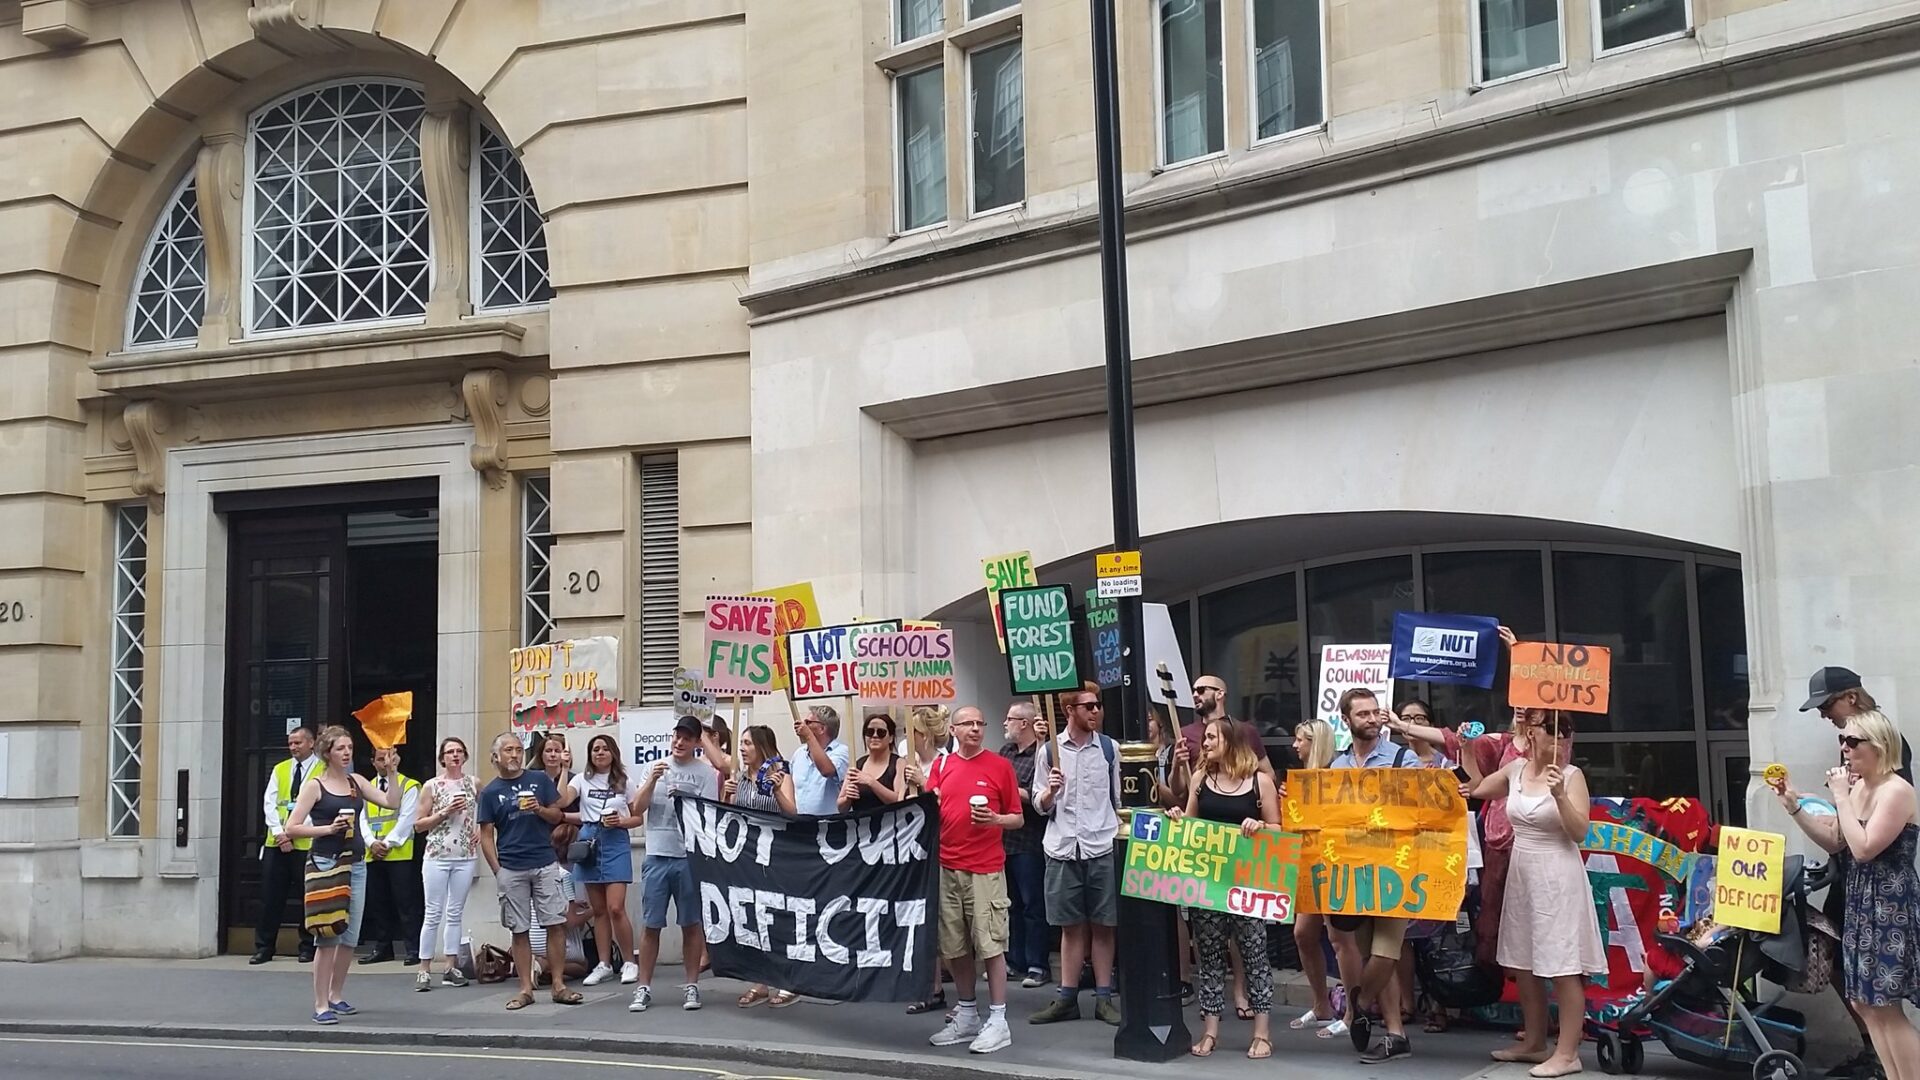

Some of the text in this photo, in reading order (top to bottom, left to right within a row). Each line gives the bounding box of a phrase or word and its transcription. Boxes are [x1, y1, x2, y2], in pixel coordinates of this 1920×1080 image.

[568, 569, 601, 594] 20
[985, 555, 1033, 593] SAVE
[0, 601, 24, 623] 20
[709, 603, 772, 636] SAVE
[1003, 590, 1067, 621] FUND
[803, 628, 846, 664] NOT
[857, 633, 951, 660] SCHOOLS
[1006, 620, 1075, 649] FOREST
[1439, 633, 1475, 654] NUT
[708, 639, 771, 685] FHS
[858, 660, 954, 678] JUST WANNA
[1011, 650, 1076, 682] FUND
[1409, 656, 1477, 669] www.teachers.org.uk
[1541, 644, 1590, 667] NO
[513, 671, 598, 697] CUT OUR
[794, 661, 859, 695] DEFIC
[859, 678, 956, 699] HAVE FUNDS
[1123, 674, 1131, 686] 5
[681, 690, 708, 706] OUR
[1537, 680, 1601, 706] CUTS
[634, 733, 674, 745] Depart
[1294, 769, 1457, 812] TEACHERS
[682, 797, 928, 866] NOT OUR
[1167, 819, 1242, 855] FIGHT
[1727, 835, 1774, 856] NOT
[1130, 842, 1228, 882] FOREST
[1234, 857, 1290, 892] HILL
[1732, 859, 1768, 881] OUR
[1125, 869, 1291, 920] SCHOOL CUTS
[1311, 862, 1429, 914] FUNDS
[1718, 885, 1780, 914] DEFICIT
[700, 881, 927, 972] DEFICIT
